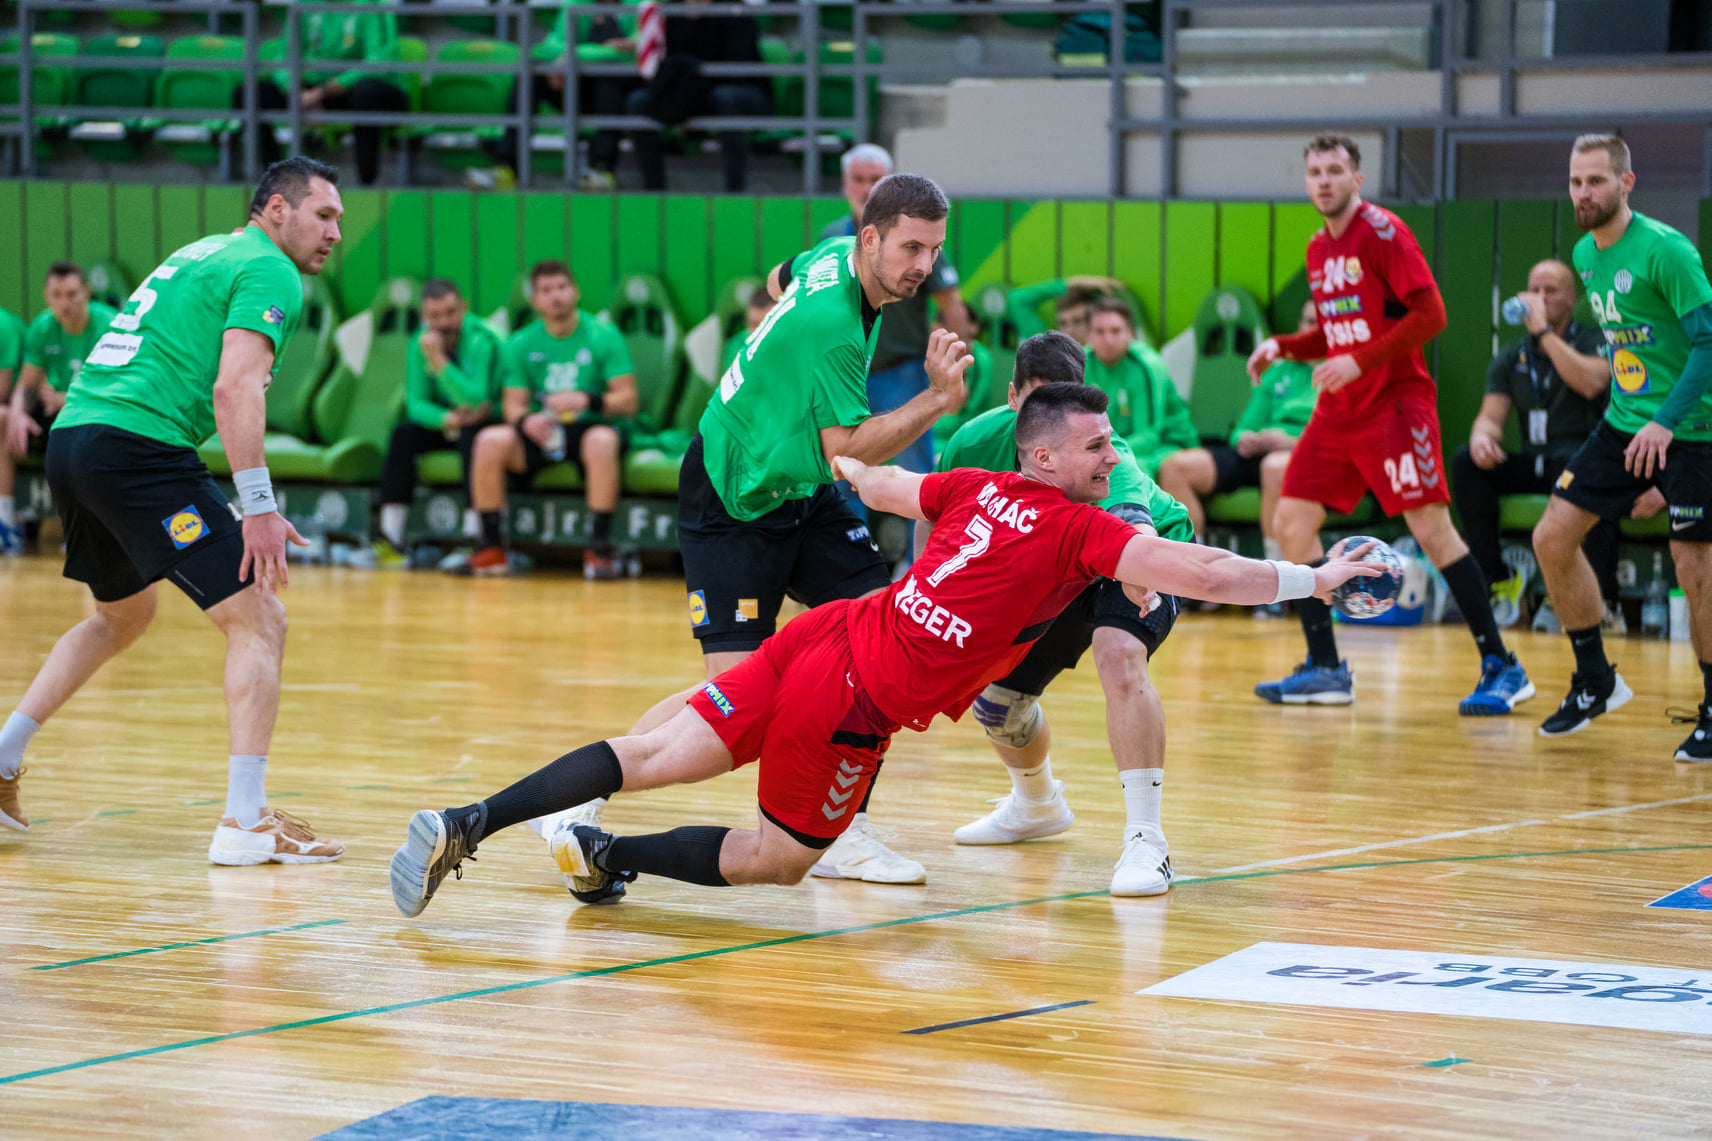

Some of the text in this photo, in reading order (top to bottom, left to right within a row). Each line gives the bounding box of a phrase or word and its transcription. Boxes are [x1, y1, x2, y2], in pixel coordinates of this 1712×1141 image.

[110, 265, 179, 331] 5
[1591, 290, 1622, 324] 94
[1384, 452, 1419, 494] 24
[926, 514, 993, 588] 7
[1266, 964, 1712, 1006] garia
